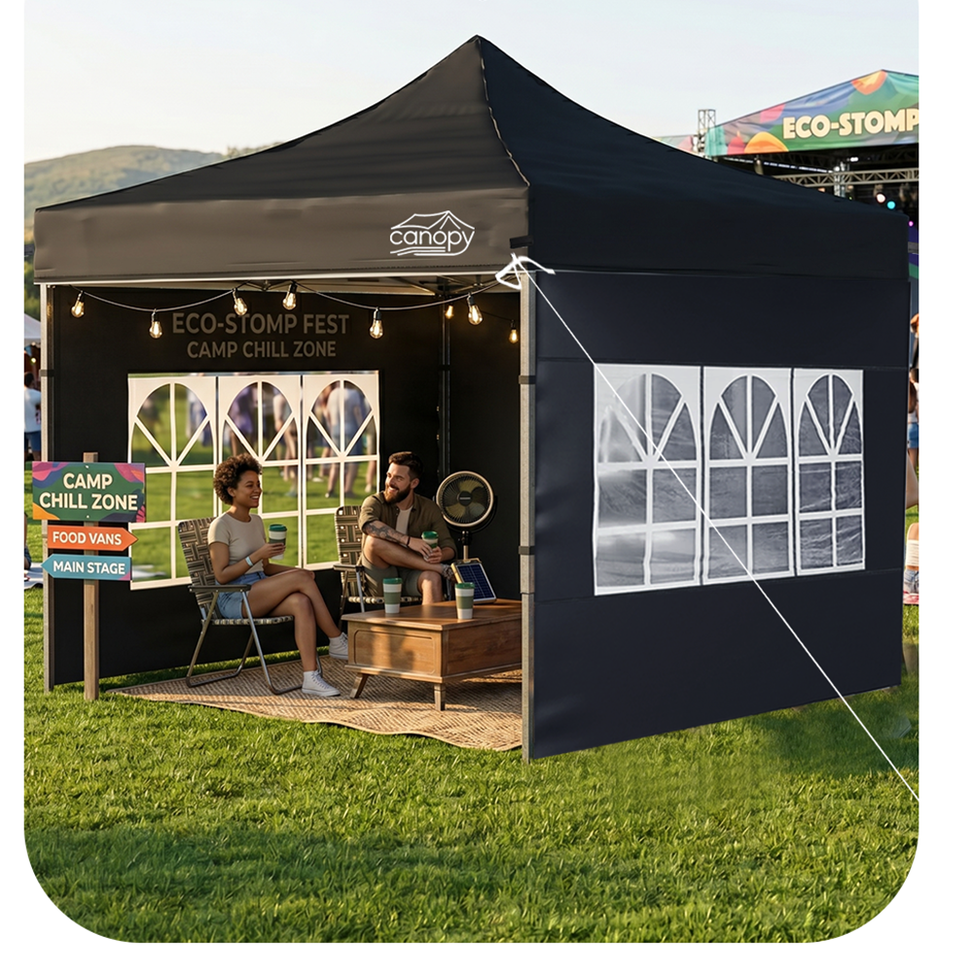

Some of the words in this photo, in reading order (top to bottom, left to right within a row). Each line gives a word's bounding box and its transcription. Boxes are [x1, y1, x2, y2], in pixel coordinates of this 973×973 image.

[783, 108, 920, 140] ECO-STOMP
[390, 230, 475, 256] canopy
[172, 312, 298, 335] ECO-STOMP
[303, 313, 350, 335] FEST
[187, 340, 239, 359] CAMP
[242, 340, 290, 359] CHILL
[293, 340, 337, 358] ZONE
[63, 472, 114, 490] CAMP
[39, 491, 88, 509] CHILL
[91, 493, 139, 511] ZONE
[52, 531, 87, 545] FOOD
[88, 532, 123, 546] VANS
[53, 559, 85, 573] MAIN
[87, 561, 126, 575] STAGE
